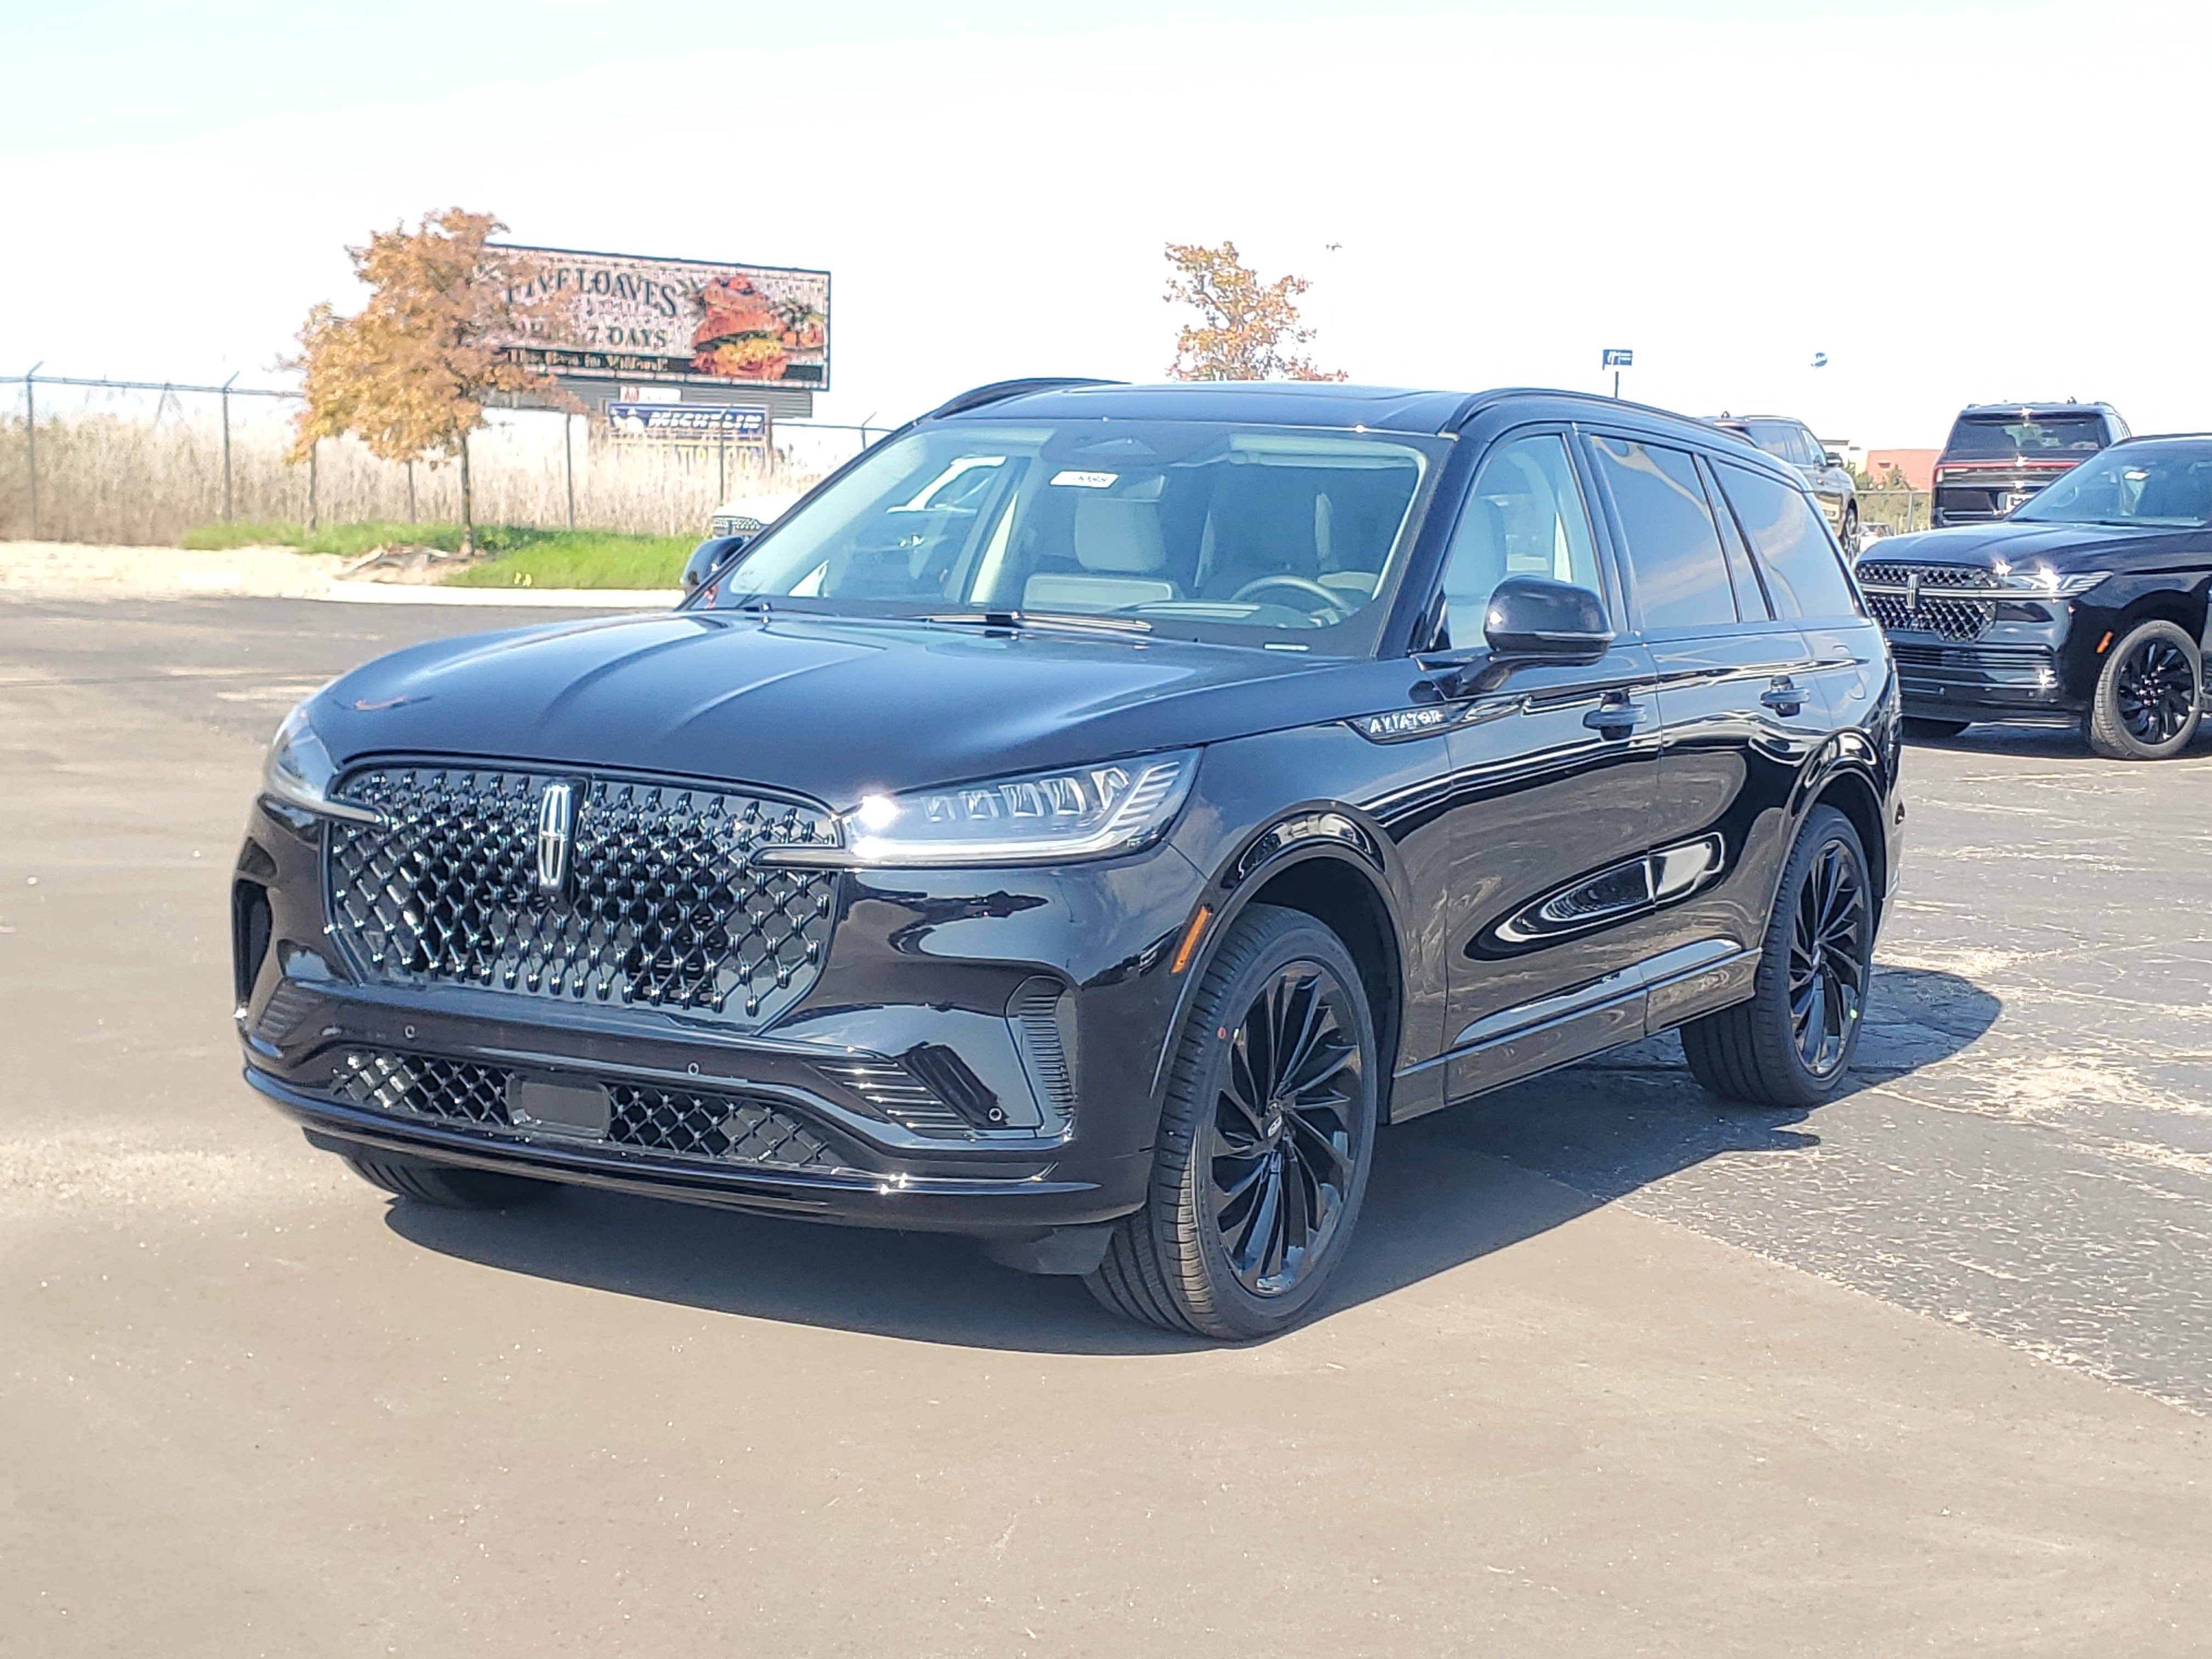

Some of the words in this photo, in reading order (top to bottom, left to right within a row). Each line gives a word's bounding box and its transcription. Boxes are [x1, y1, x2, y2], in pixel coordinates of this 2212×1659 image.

[575, 268, 677, 317] LOAVES
[607, 325, 667, 348] DAYS
[648, 411, 763, 429] MICHELIN
[1369, 709, 1444, 733] AVIATOR
